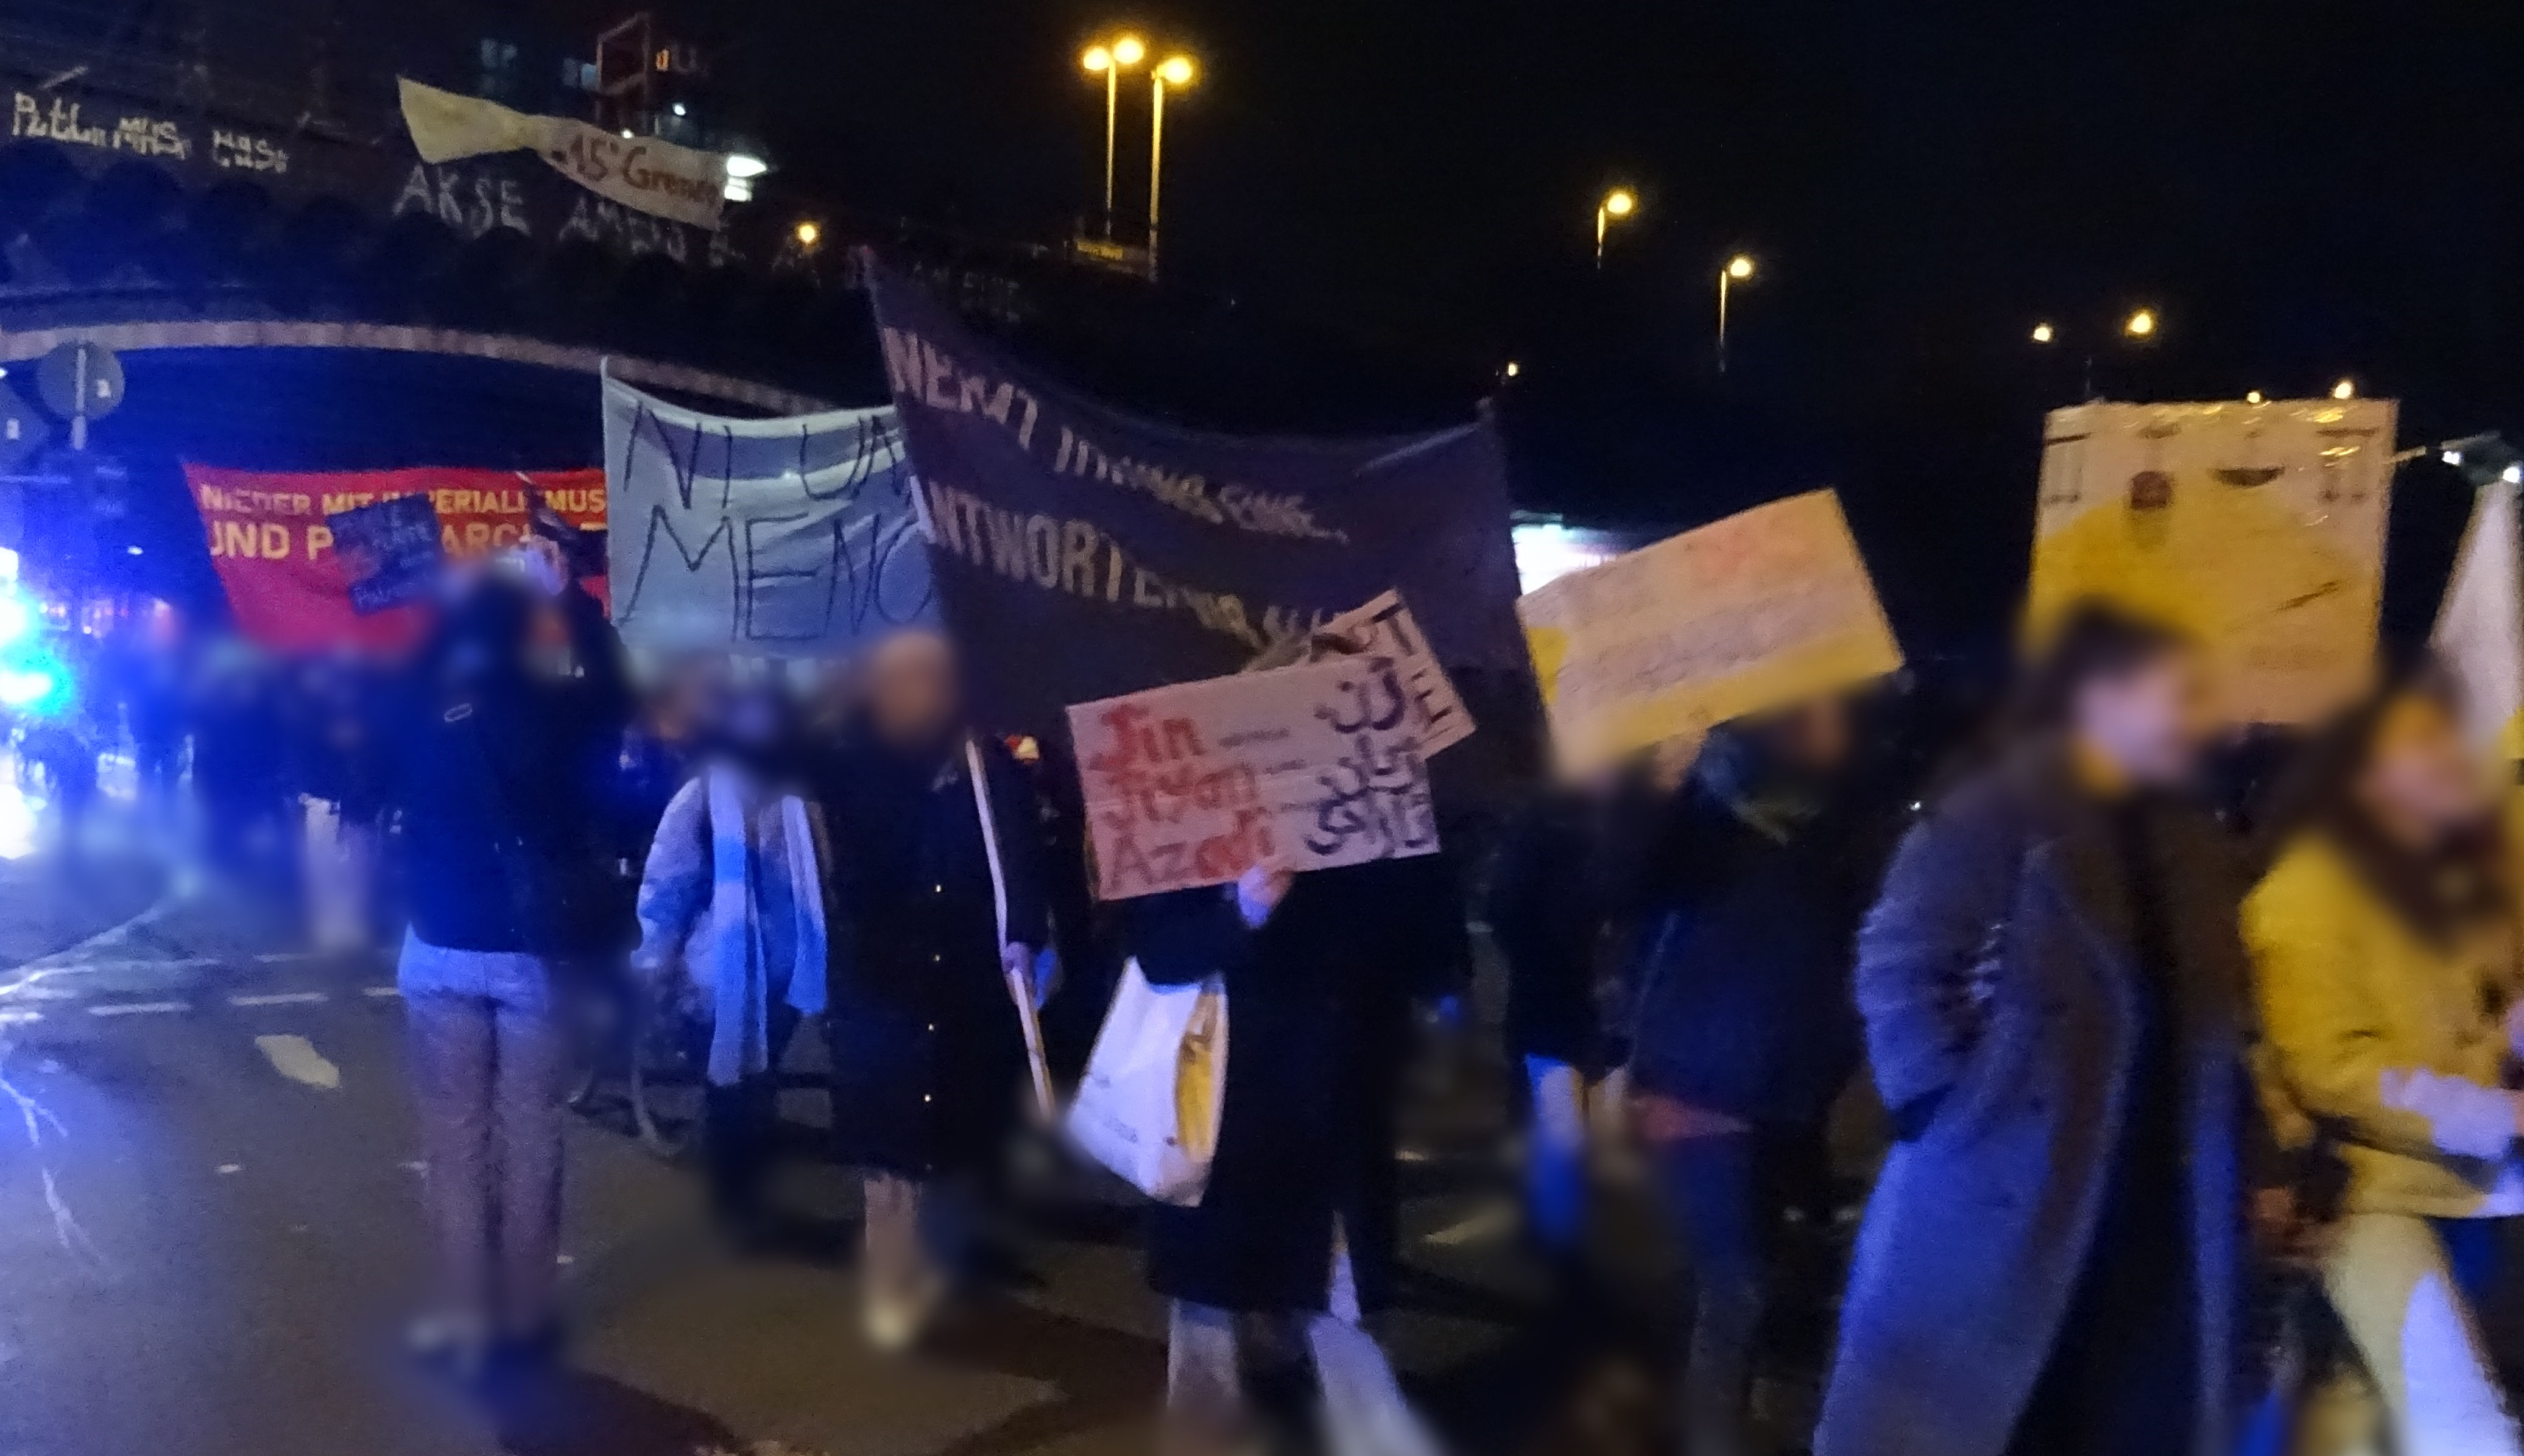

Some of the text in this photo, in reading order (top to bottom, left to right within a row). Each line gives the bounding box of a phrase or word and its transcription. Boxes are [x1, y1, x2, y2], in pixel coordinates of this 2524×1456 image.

[623, 401, 914, 510] NI UN
[617, 505, 933, 644] MENO
